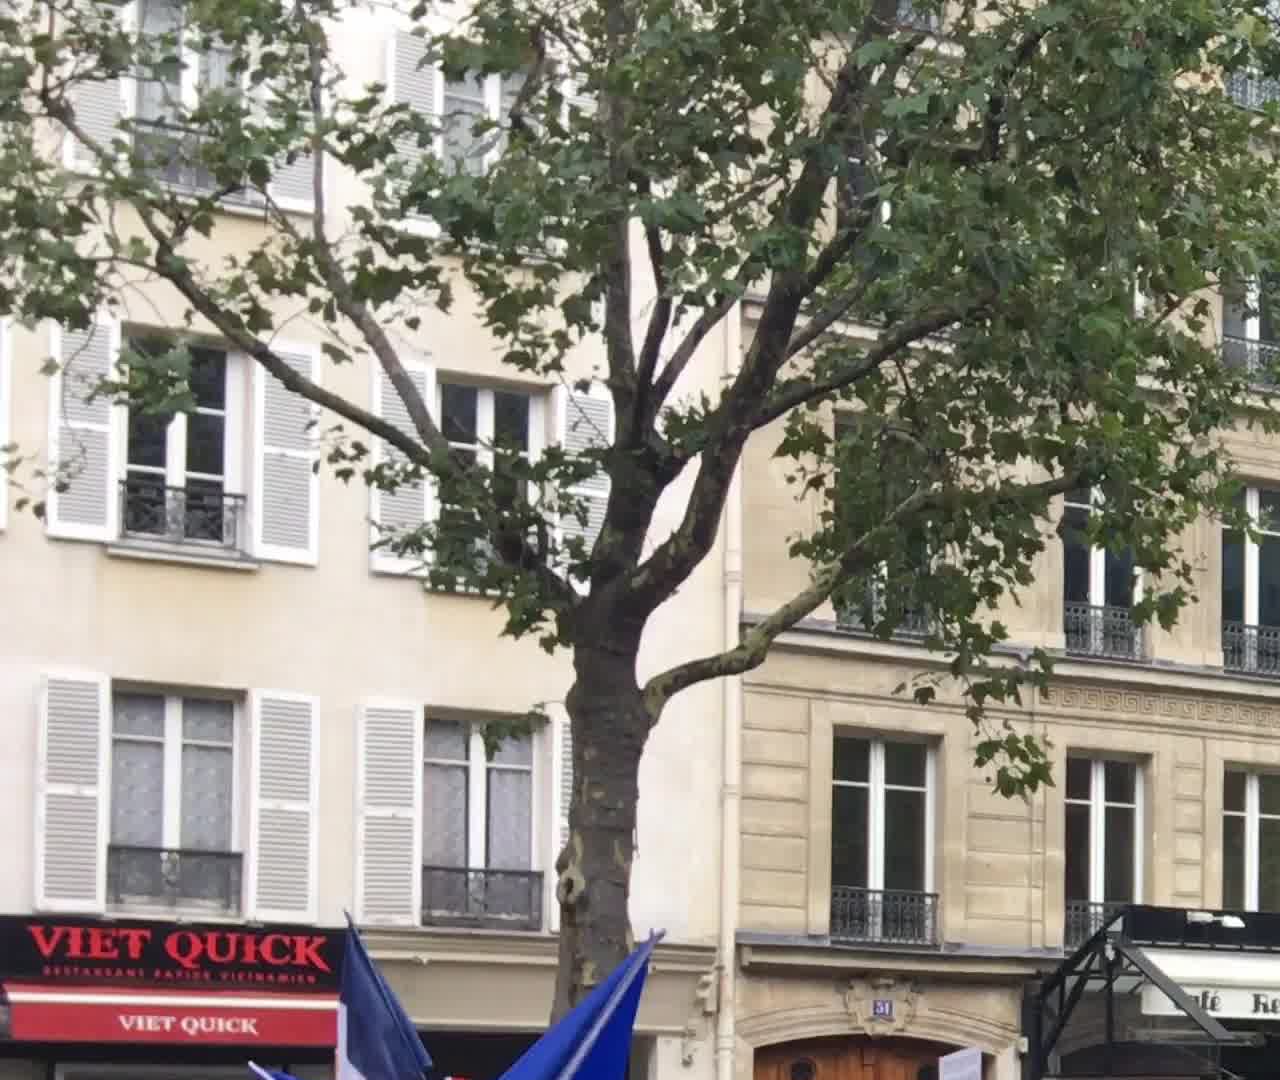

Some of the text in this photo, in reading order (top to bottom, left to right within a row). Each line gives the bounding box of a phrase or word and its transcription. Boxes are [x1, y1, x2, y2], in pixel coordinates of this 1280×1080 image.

[28, 925, 331, 973] VIET QUICK
[119, 1014, 259, 1037] VIET QUICK
